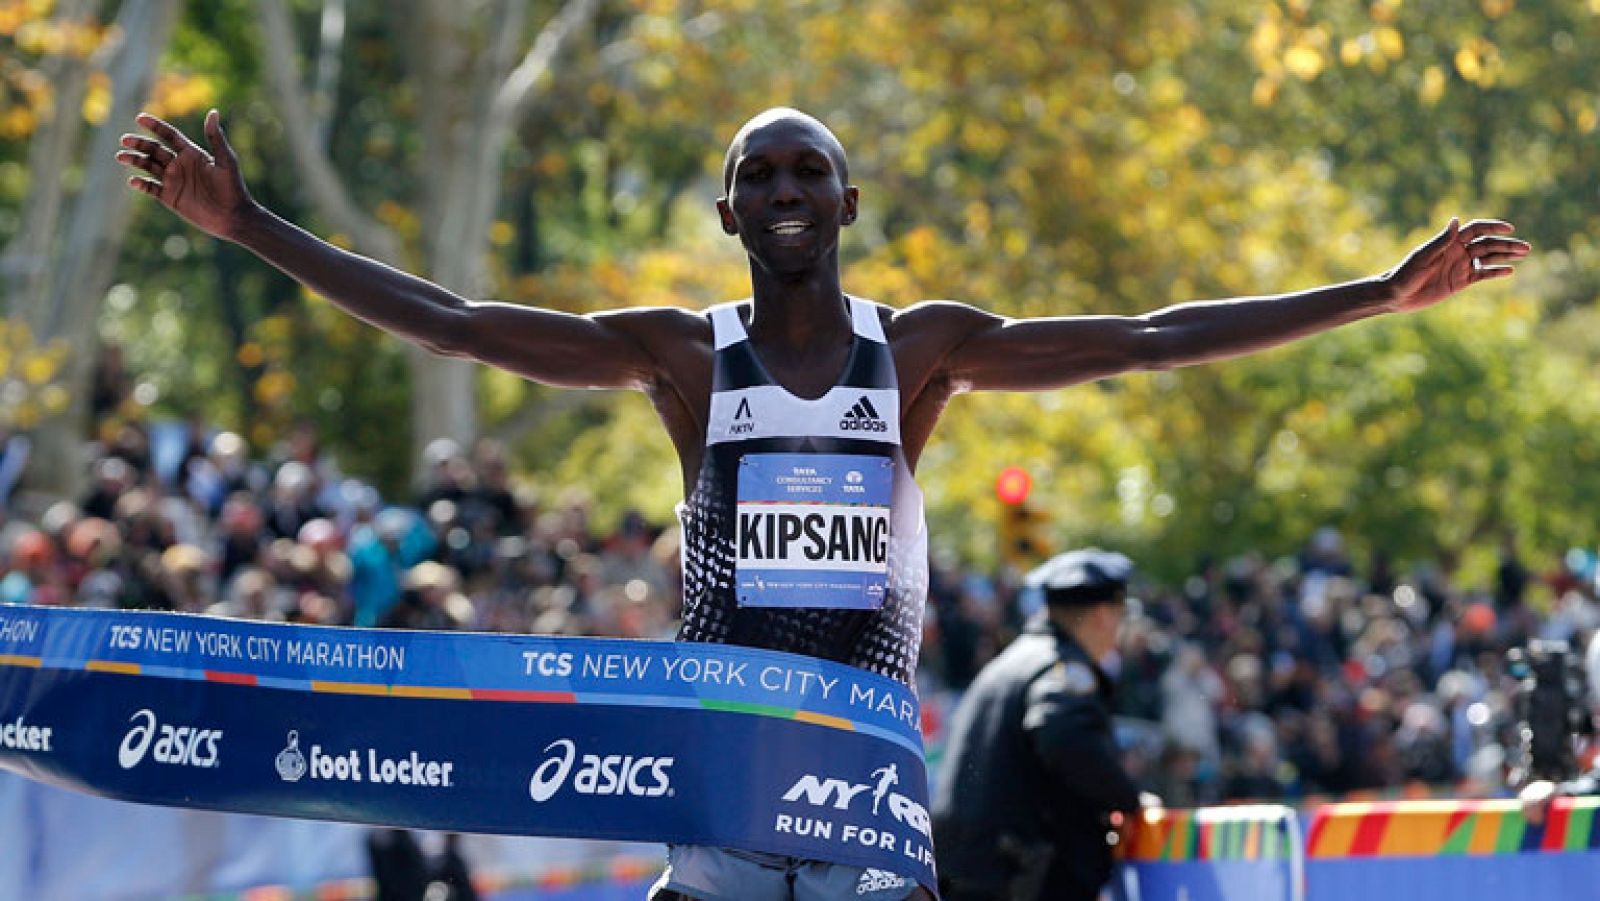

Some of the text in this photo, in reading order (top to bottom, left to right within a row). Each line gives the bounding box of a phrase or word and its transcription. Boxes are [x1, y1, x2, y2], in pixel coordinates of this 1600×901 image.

[839, 418, 888, 433] adidas
[739, 513, 887, 564] KIPSANG
[109, 625, 405, 671] TCS NEW YORK CITY MARATHON
[522, 651, 573, 677] TCS
[582, 654, 651, 681] NEW
[662, 656, 748, 687] YORK
[759, 666, 838, 700] CITY
[0, 717, 52, 751] cker
[368, 748, 453, 788] Locker
[775, 814, 937, 877] RUN FOR LIF
